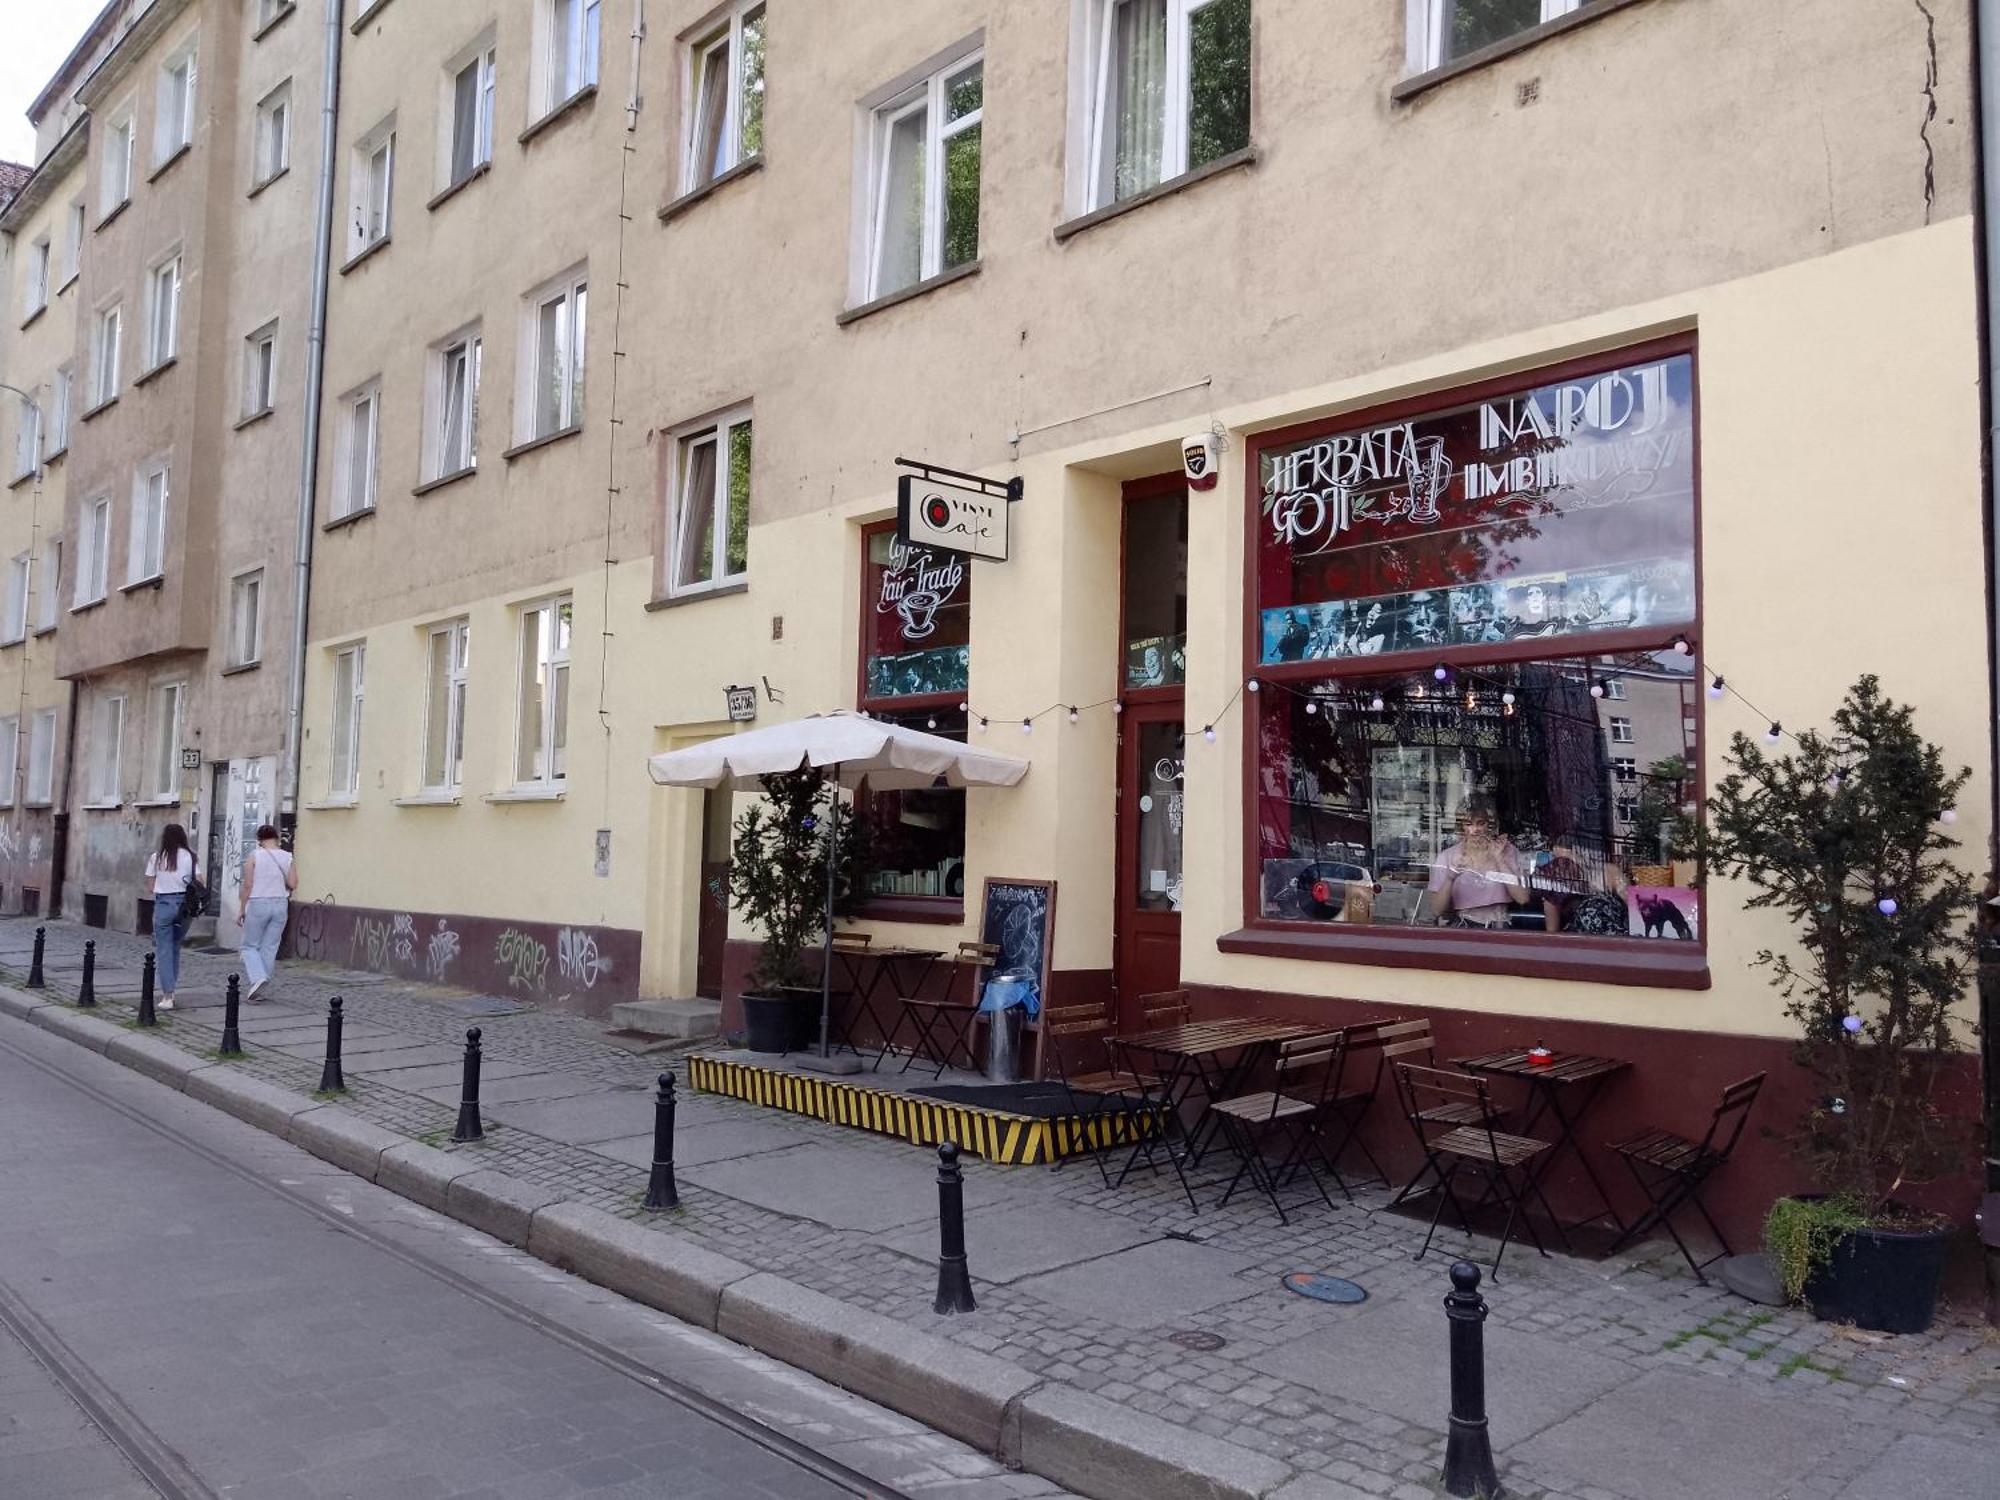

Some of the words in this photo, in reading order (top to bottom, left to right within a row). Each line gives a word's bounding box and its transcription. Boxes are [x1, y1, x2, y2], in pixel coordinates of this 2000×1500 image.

[1480, 364, 1668, 450] NAPÓJ
[1265, 422, 1424, 494] HERBATA
[1272, 480, 1350, 553] GOJI
[877, 569, 914, 612] Fair
[908, 555, 963, 598] Trade
